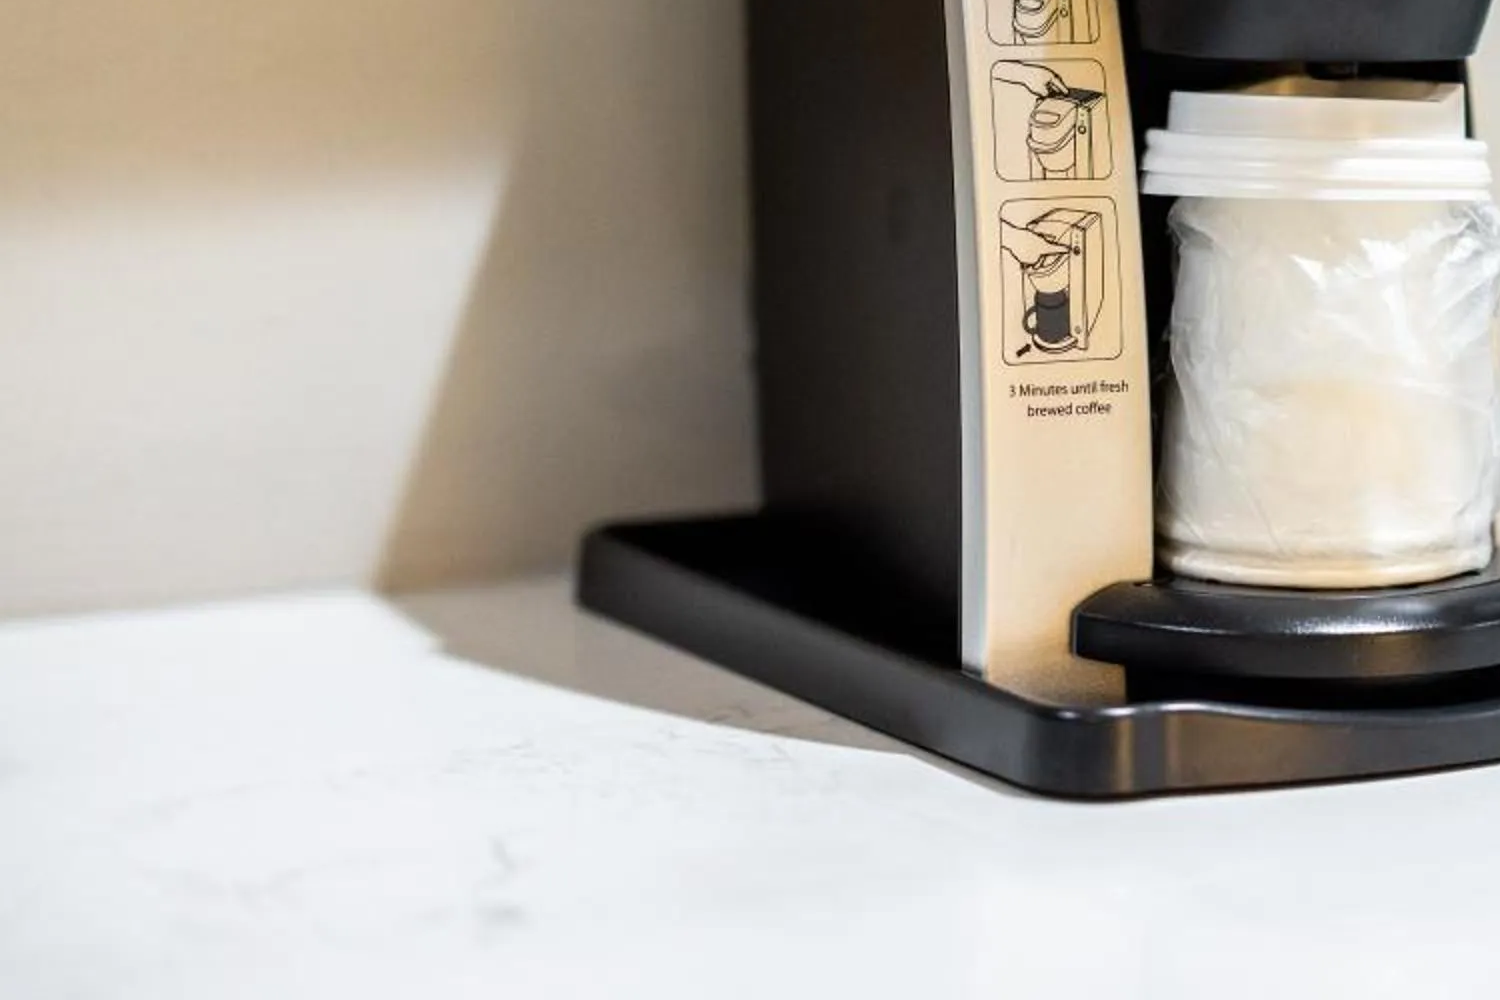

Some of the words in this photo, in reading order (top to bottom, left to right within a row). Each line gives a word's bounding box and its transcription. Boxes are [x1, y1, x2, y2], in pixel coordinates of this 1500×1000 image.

[1009, 384, 1017, 398] 3
[1019, 383, 1068, 397] Minutes
[1071, 381, 1097, 395] until
[1099, 379, 1129, 393] fresh
[1027, 402, 1073, 417] brewed
[1075, 400, 1112, 415] coffee
